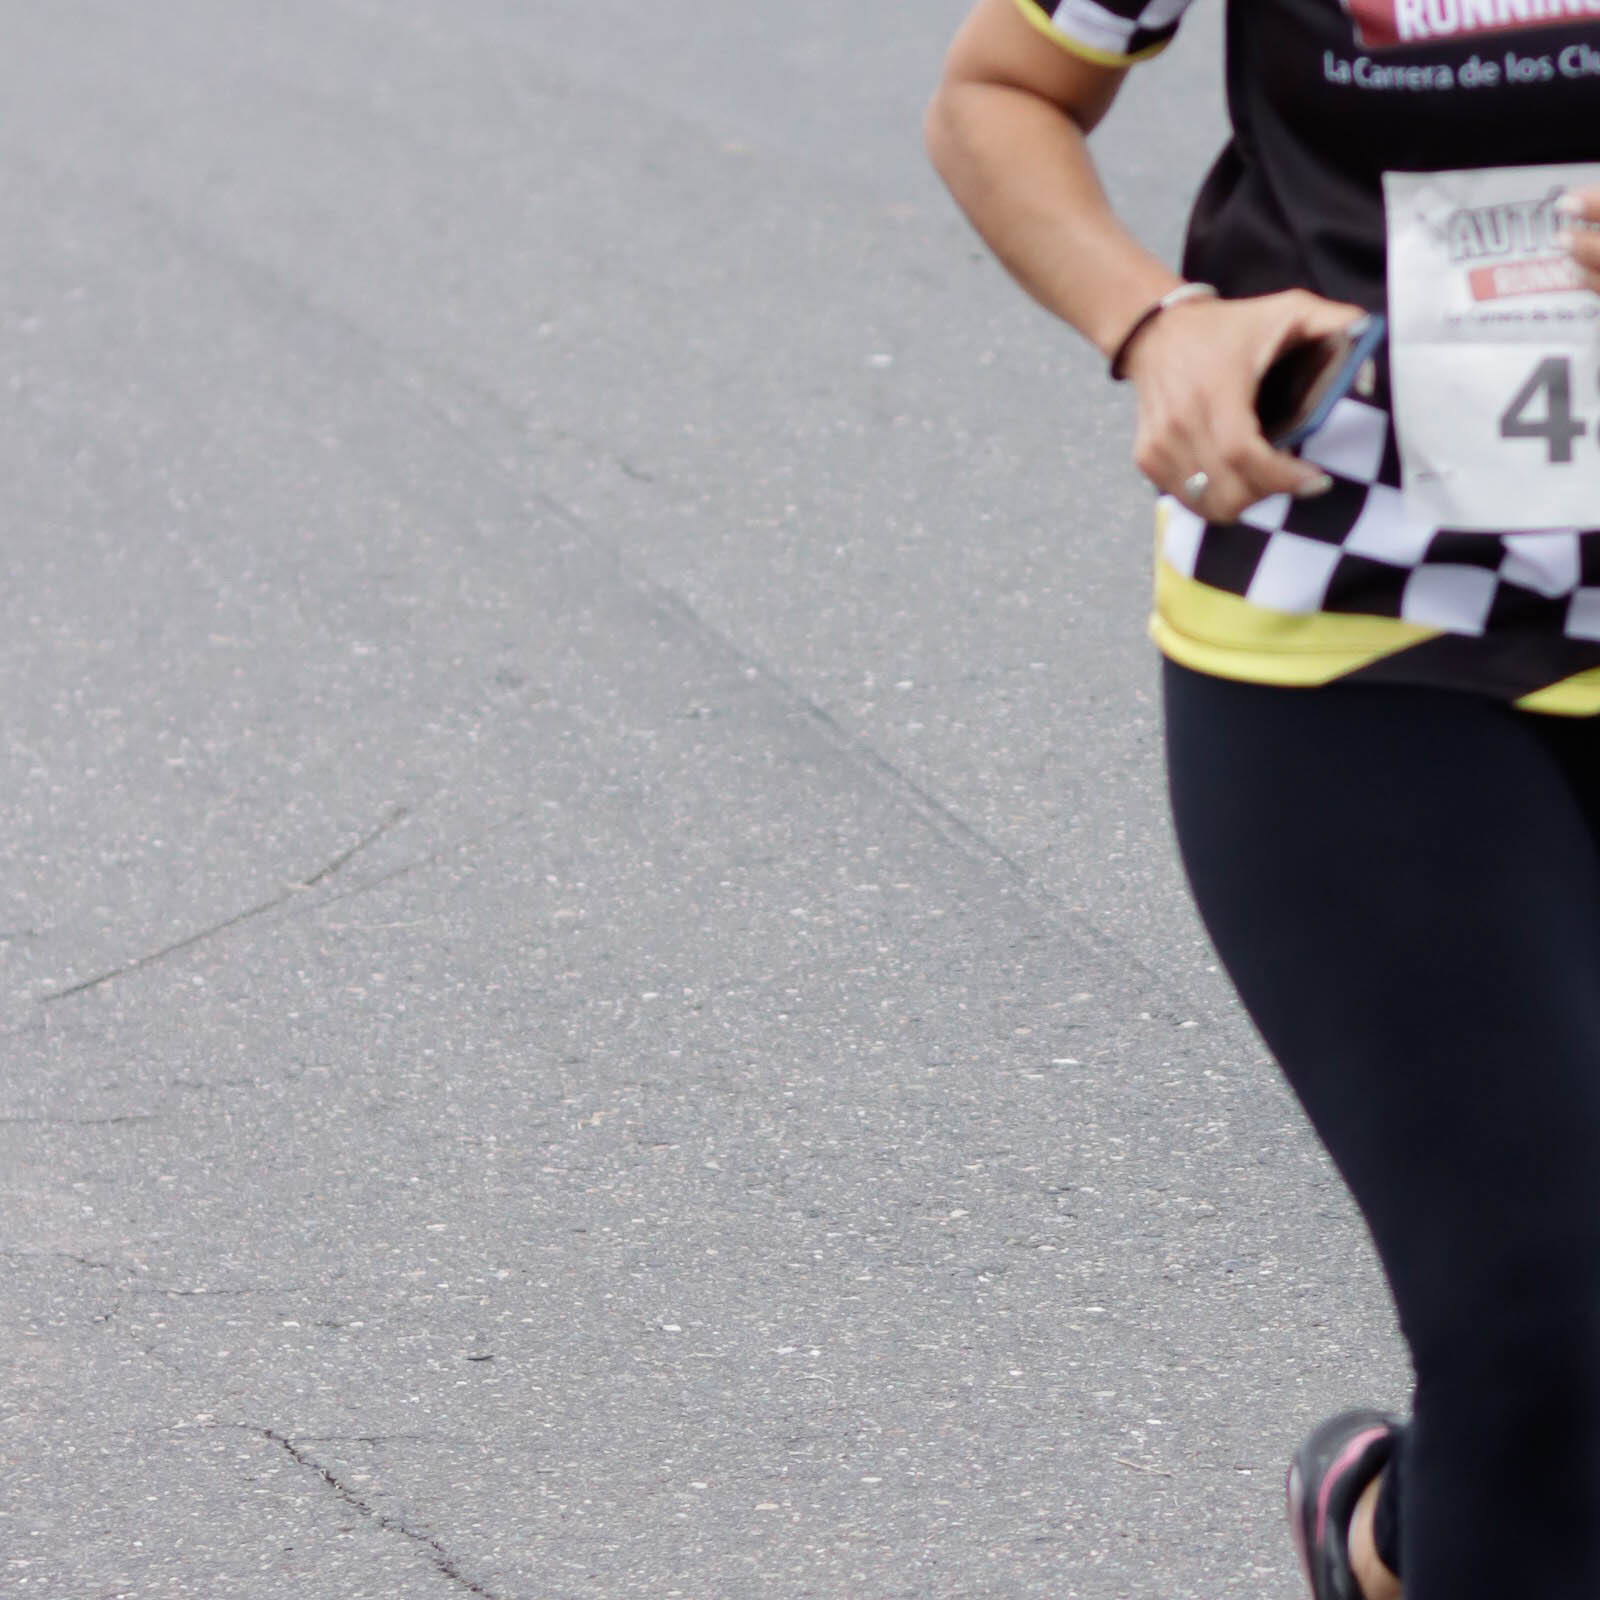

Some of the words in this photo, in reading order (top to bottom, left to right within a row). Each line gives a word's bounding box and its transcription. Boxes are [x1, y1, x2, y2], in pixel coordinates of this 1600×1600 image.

[1352, 55, 1455, 90] Carrera
[1458, 53, 1500, 88] de
[1504, 50, 1555, 84] los
